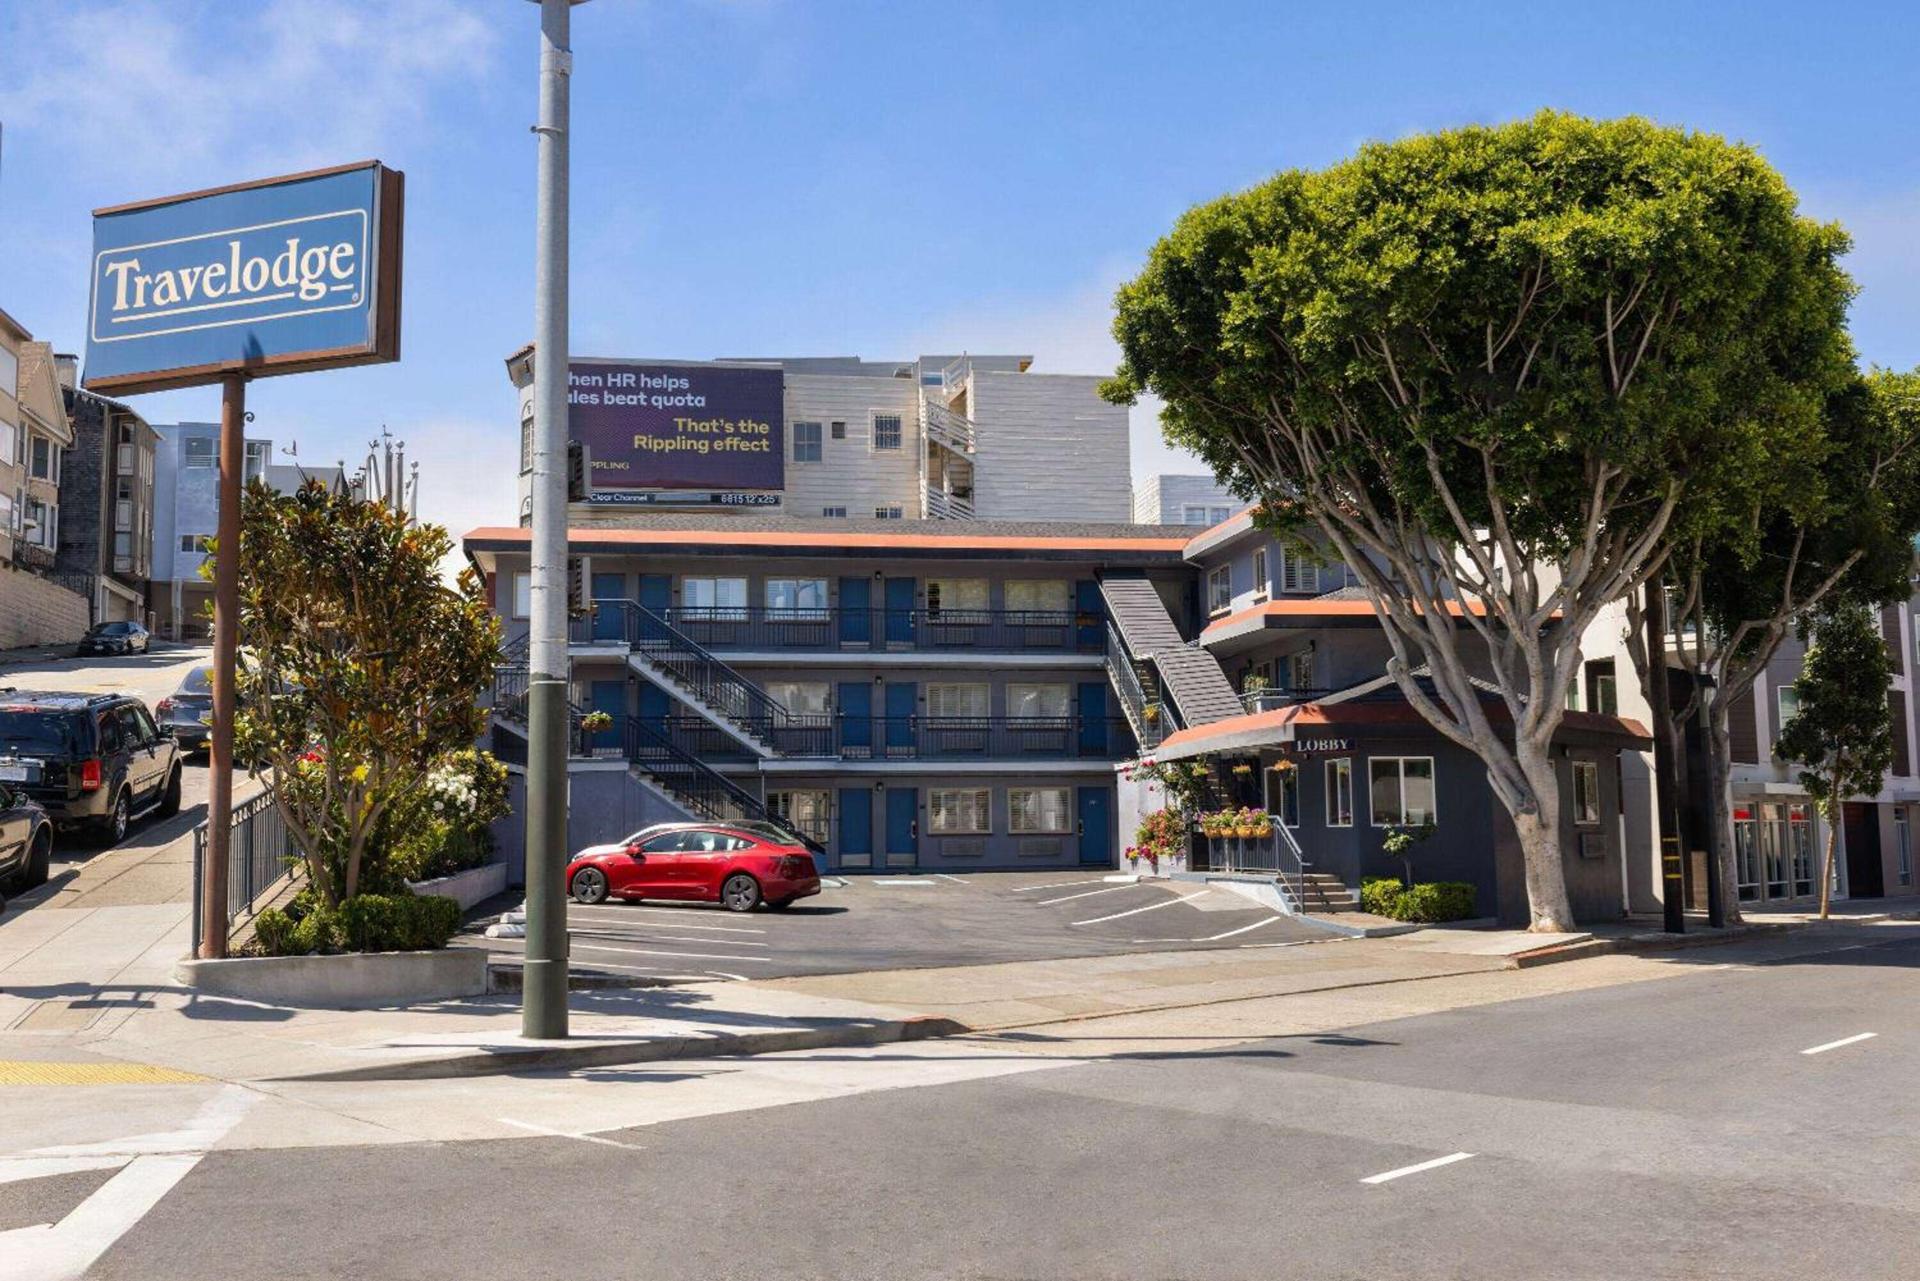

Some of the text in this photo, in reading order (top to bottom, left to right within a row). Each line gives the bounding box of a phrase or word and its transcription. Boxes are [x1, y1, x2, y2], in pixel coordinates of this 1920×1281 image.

[105, 237, 355, 311] Travelodge
[568, 371, 690, 392] hen HR helps
[603, 390, 647, 406] beat
[651, 392, 706, 410] quota
[673, 418, 770, 434] That's the
[634, 434, 770, 454] Rippling effect
[591, 461, 630, 470] PPLING
[613, 493, 648, 501] Channel
[1296, 739, 1350, 752] LOBBY
